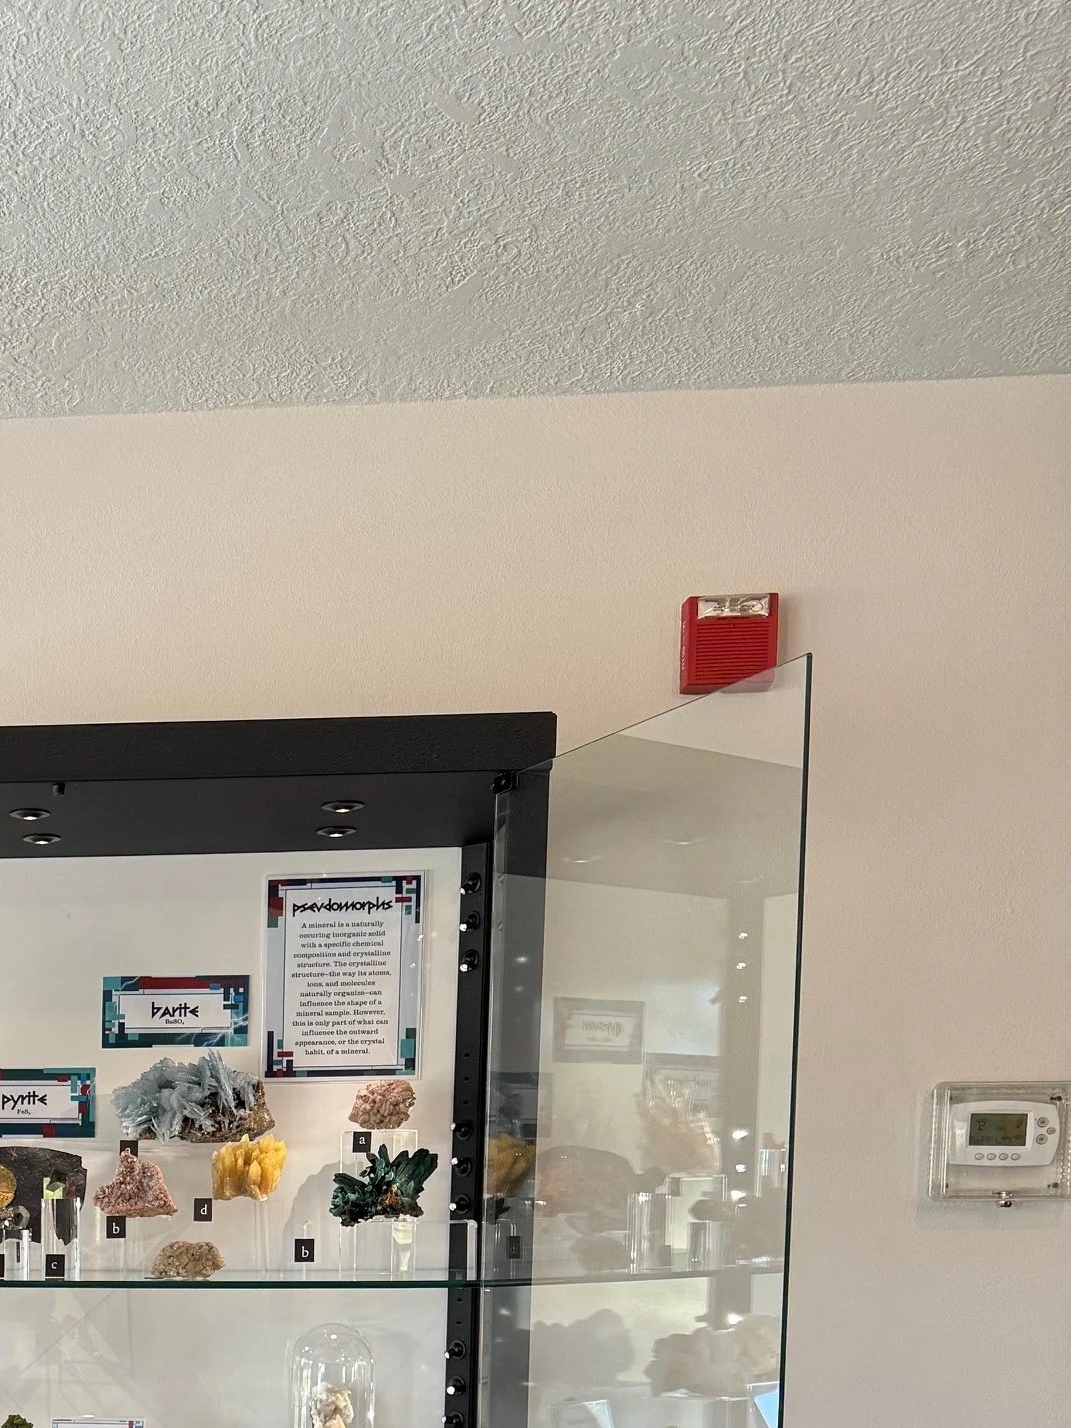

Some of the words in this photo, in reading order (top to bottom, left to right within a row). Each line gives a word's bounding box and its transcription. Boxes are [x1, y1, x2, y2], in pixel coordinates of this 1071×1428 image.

[324, 941, 351, 949] specific
[353, 950, 391, 958] crystalline
[349, 960, 386, 968] crystalline
[152, 1002, 199, 1019] barite
[2, 1091, 47, 1110] pyrite
[359, 1136, 366, 1144] a
[200, 1204, 207, 1215] d
[112, 1223, 120, 1234] b
[301, 1246, 309, 1258] b
[51, 1261, 57, 1269] c
